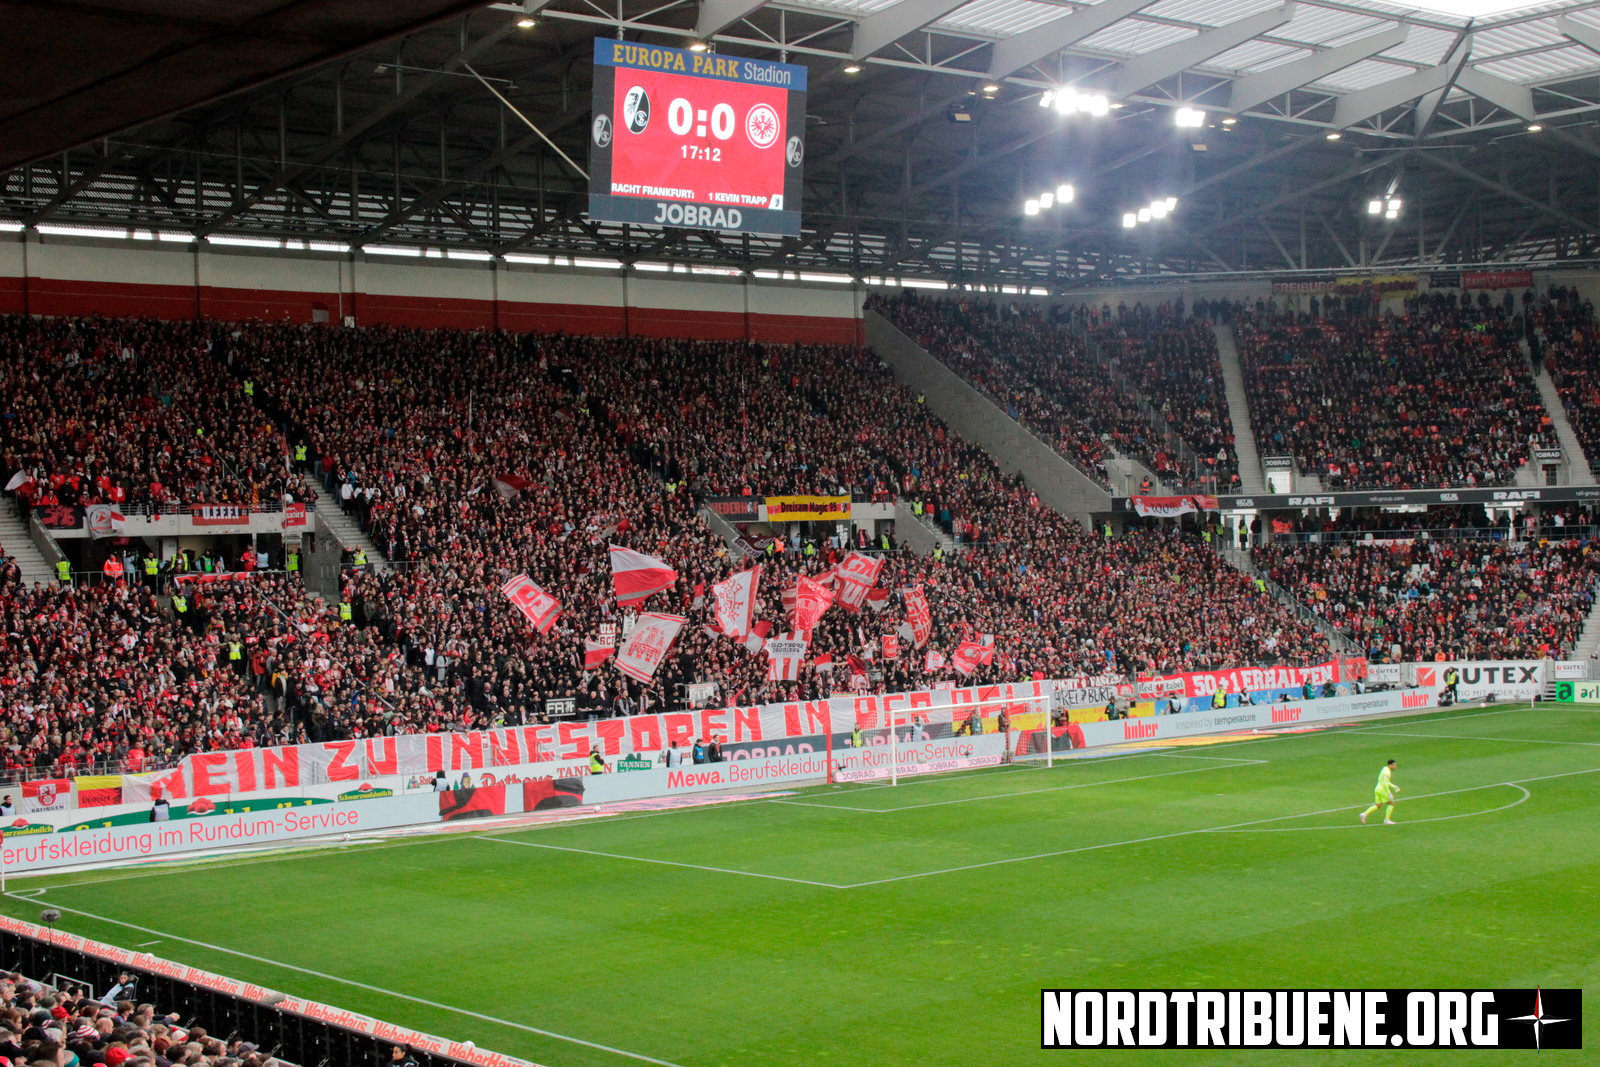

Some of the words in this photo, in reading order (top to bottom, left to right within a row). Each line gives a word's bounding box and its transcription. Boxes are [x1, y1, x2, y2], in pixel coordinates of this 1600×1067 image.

[613, 44, 686, 71] EUROPA
[693, 56, 739, 78] PARK
[744, 62, 791, 85] Stadion
[668, 97, 735, 140] 0:0
[681, 144, 721, 162] 17:12
[611, 182, 642, 195] RACHT
[642, 186, 695, 199] FRANKFURT:
[708, 192, 713, 200] 1
[715, 193, 740, 203] KEVIN
[741, 195, 767, 205] TRAPP
[654, 203, 742, 229] JOBRAD
[1265, 458, 1290, 466] JOBRAD
[1535, 451, 1560, 459] JOBRAD
[1288, 496, 1335, 506] RAFI
[1493, 491, 1540, 500] RAFI
[780, 502, 808, 513] Dreisam
[810, 502, 828, 515] Magic
[1192, 672, 1240, 696] 50+1
[1241, 664, 1333, 691] ERHALTEN
[1443, 665, 1538, 685] GUTEX
[1316, 700, 1342, 714] Inspired
[1343, 700, 1350, 712] by
[1351, 698, 1388, 712] temperature
[1402, 690, 1429, 708] huber
[1175, 718, 1203, 730] Inspired
[1204, 716, 1213, 728] by
[1214, 713, 1256, 728] temperature
[1271, 705, 1302, 723] huber
[323, 736, 398, 781] ZU
[427, 706, 763, 774] INVESTOREN
[783, 701, 829, 738] IN
[853, 692, 932, 730] DER
[1124, 720, 1158, 740] huber
[618, 761, 651, 769] TANNEN
[667, 769, 725, 789] Mewa.
[729, 752, 840, 782] Berufskleidung
[842, 753, 858, 768] im
[863, 741, 974, 766] Rundum-Service
[928, 761, 958, 771] JOBRAD
[968, 756, 998, 766] JOBRAD
[842, 771, 875, 781] JOBRAD
[886, 766, 918, 776] JOBRAD
[338, 788, 393, 802] Schwarzwaldmilch
[159, 826, 182, 847] im
[190, 809, 359, 842] Rundum-Service
[37, 927, 81, 950] WeberHaus
[83, 938, 129, 963] WeberHaus
[131, 953, 183, 979] WeberHaus
[184, 967, 239, 995] WeberHaus
[303, 1001, 368, 1032] WeberHaus
[372, 1020, 442, 1053] WeberHaus
